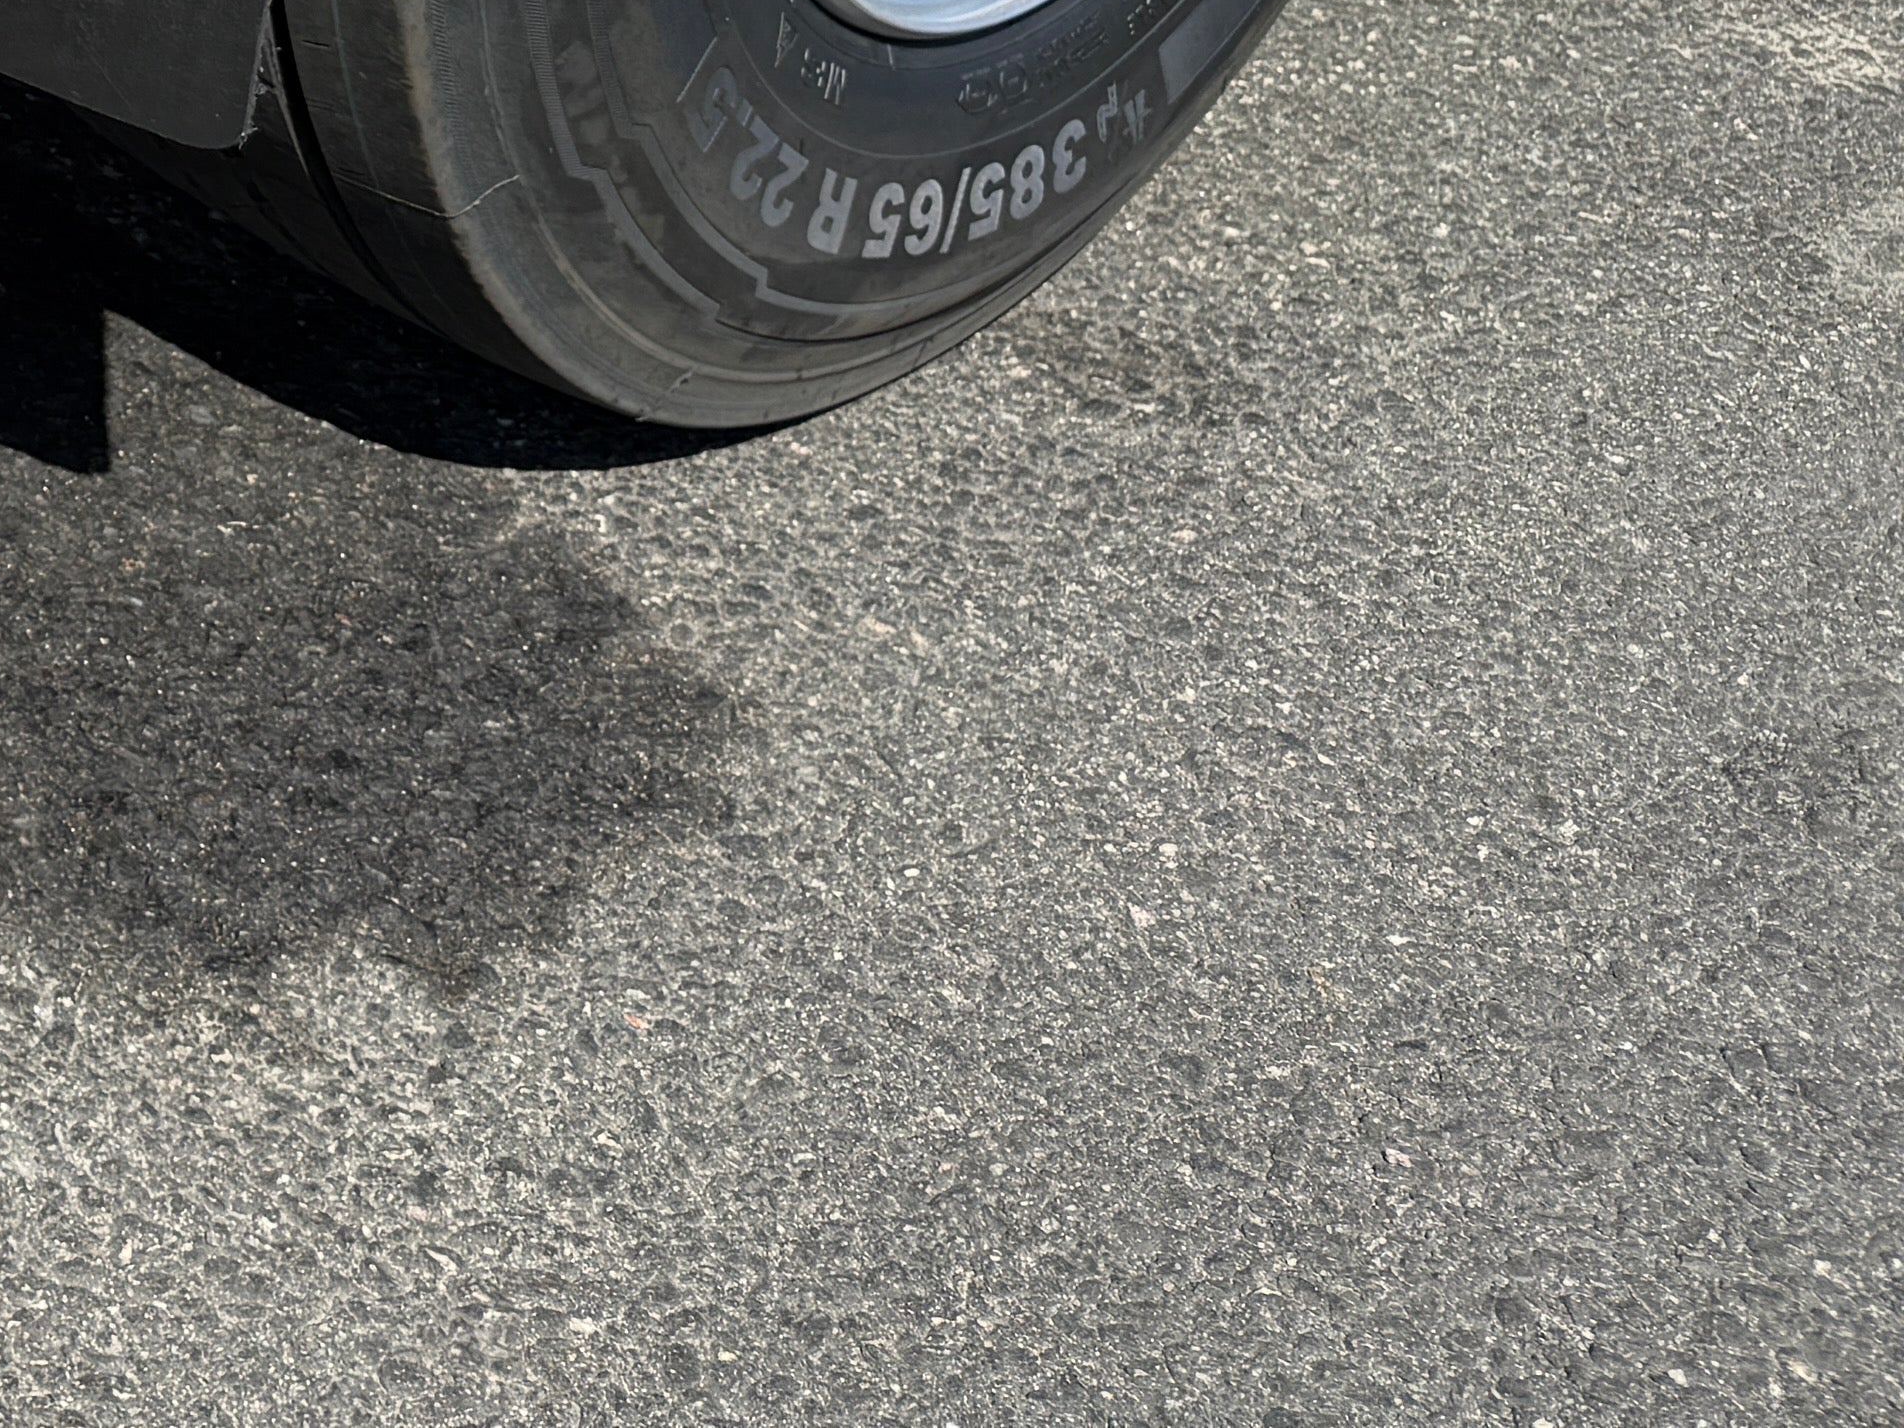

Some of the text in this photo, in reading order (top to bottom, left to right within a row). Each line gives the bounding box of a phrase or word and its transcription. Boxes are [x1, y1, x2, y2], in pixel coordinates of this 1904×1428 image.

[698, 65, 1089, 260] 385/65 R 22.5
